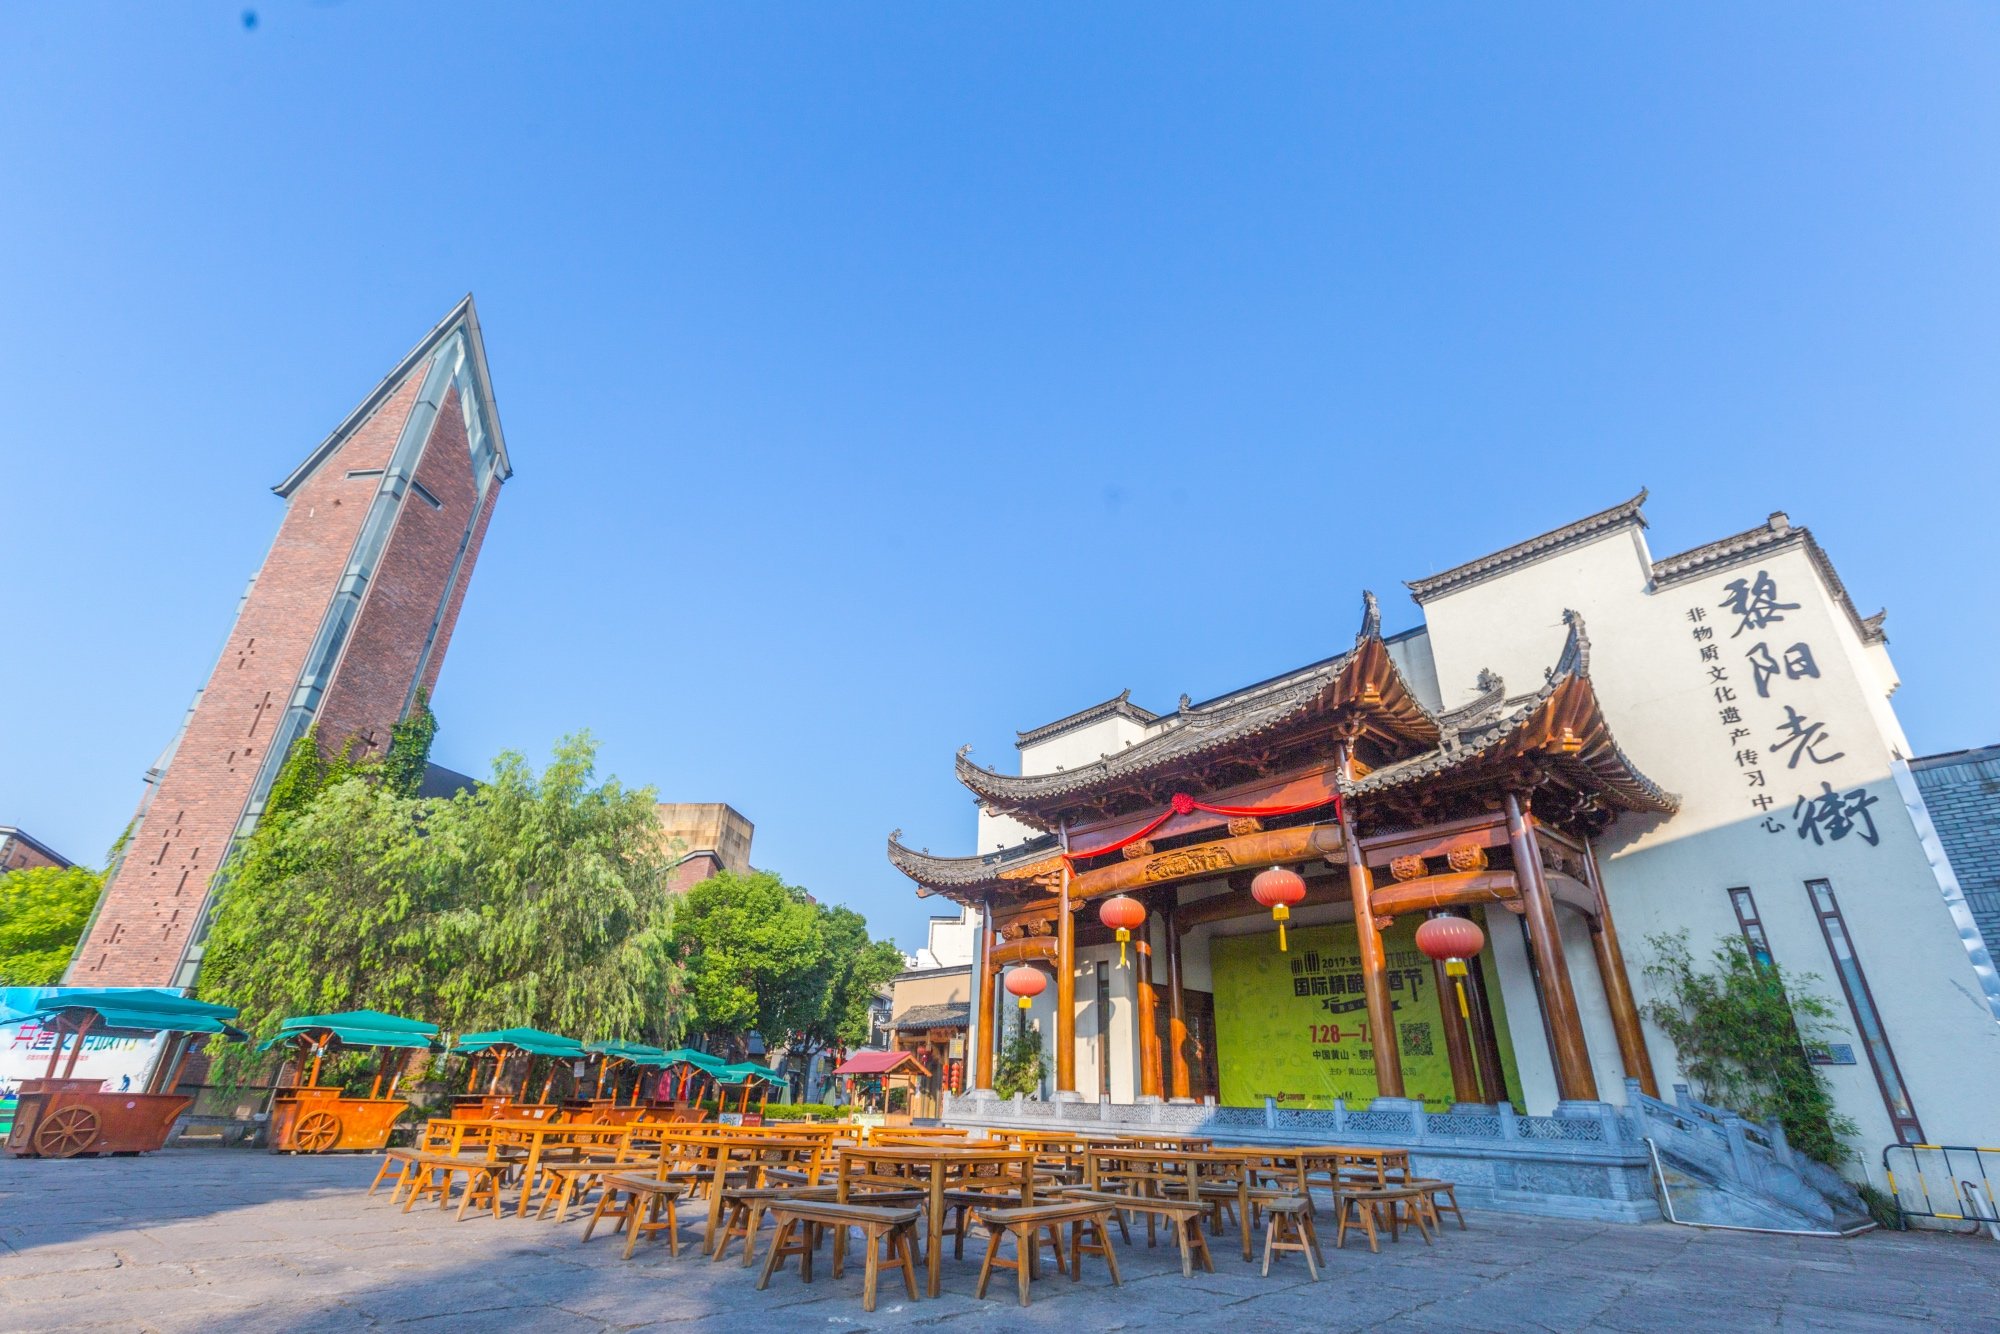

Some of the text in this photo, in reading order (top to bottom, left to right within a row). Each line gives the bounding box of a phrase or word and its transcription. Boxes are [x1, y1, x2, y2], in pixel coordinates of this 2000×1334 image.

[1686, 606, 1785, 835] 非物质文化遗产传习中心
[1718, 570, 1880, 847] 黎阳老街
[1294, 968, 1423, 1002] 国际精酿酒节
